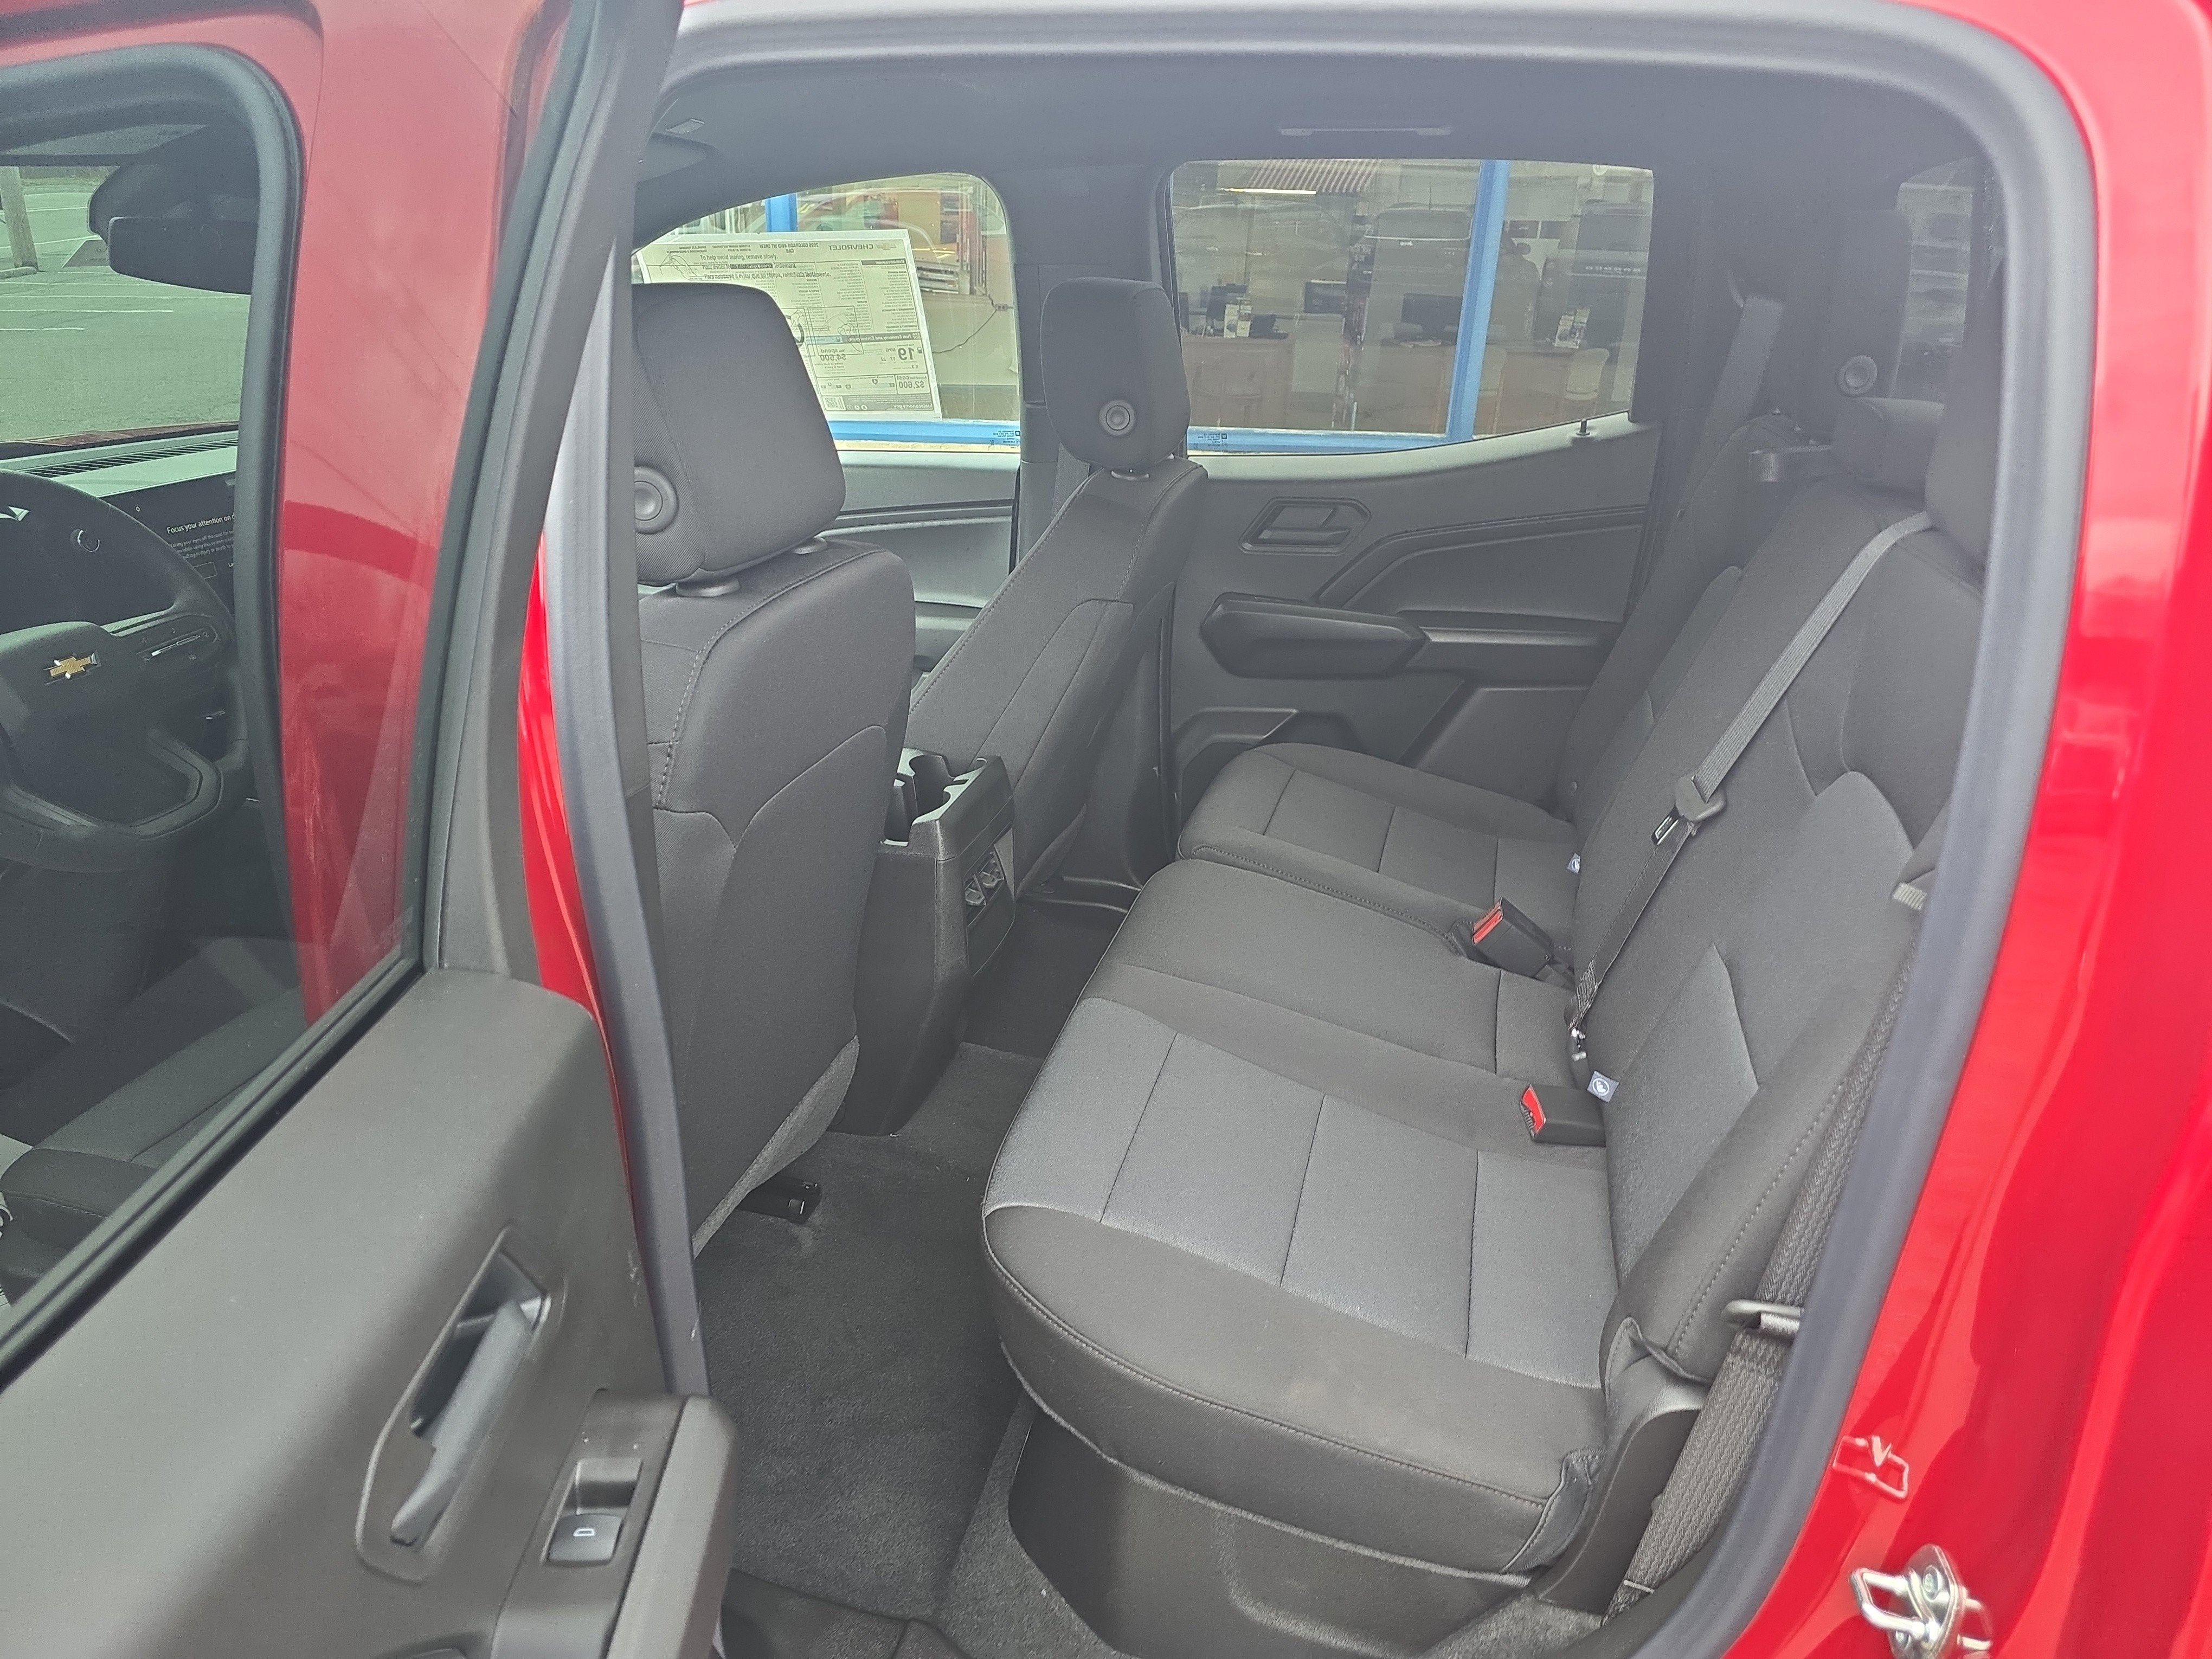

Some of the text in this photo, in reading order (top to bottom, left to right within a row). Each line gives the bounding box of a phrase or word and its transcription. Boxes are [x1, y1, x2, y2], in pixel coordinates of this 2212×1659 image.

[167, 525, 184, 534] Focus
[184, 523, 197, 532] your
[198, 517, 223, 527] attention
